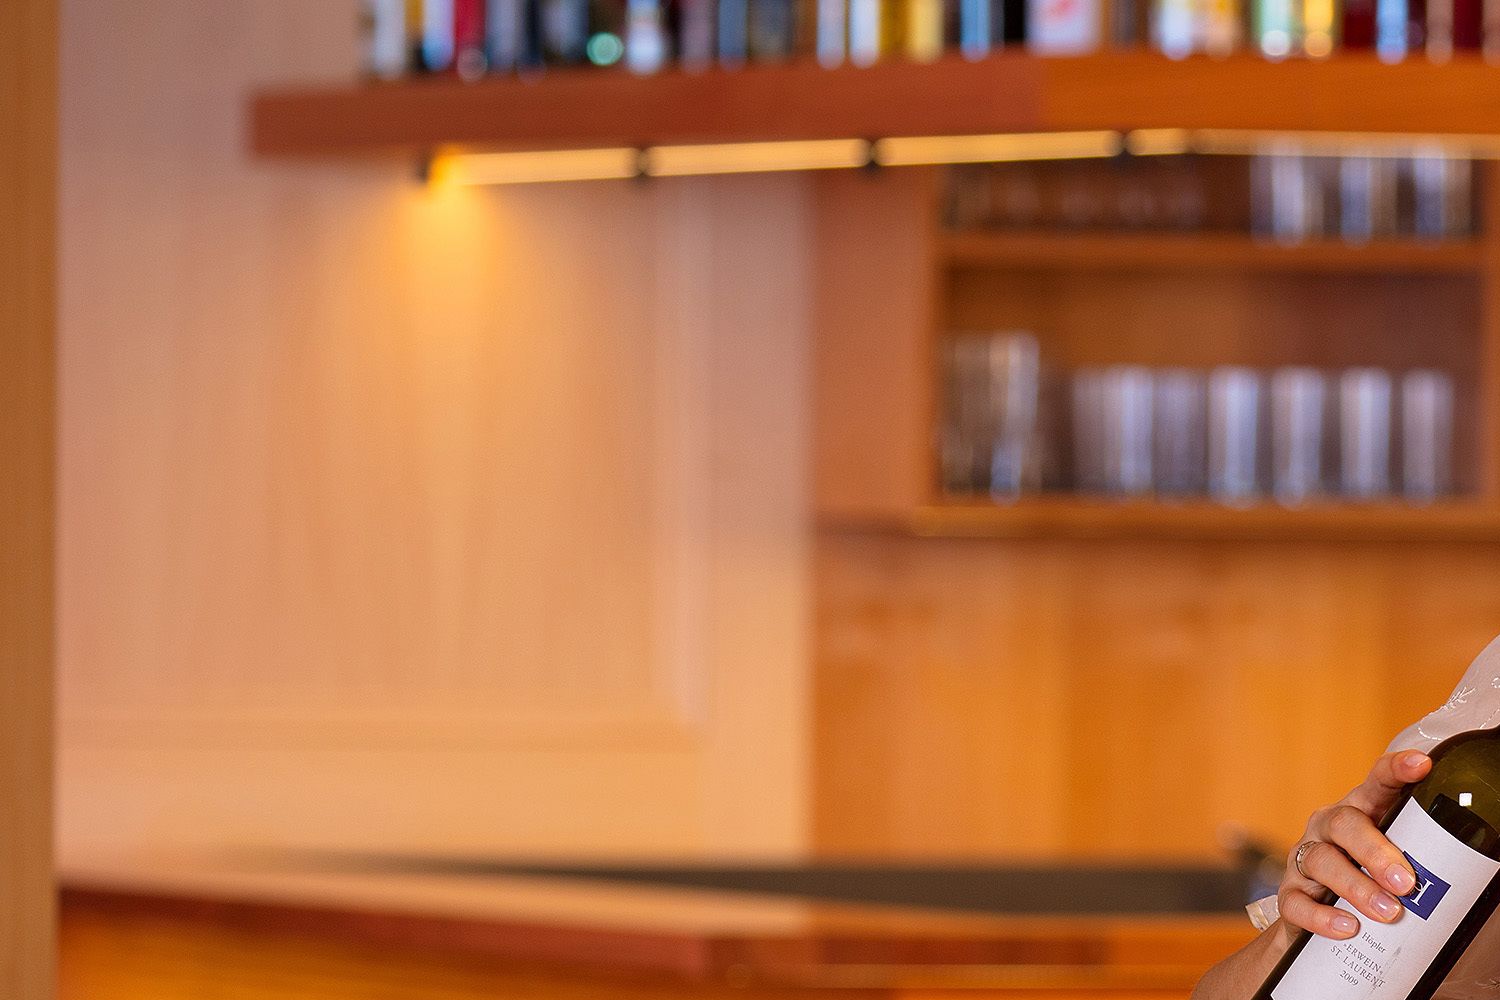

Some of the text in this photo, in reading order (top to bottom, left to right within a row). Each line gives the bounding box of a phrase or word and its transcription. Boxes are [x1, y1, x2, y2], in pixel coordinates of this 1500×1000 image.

[1361, 931, 1386, 954] Höpler
[1330, 944, 1386, 988] ST. LAURENT
[1339, 969, 1359, 986] 2009
